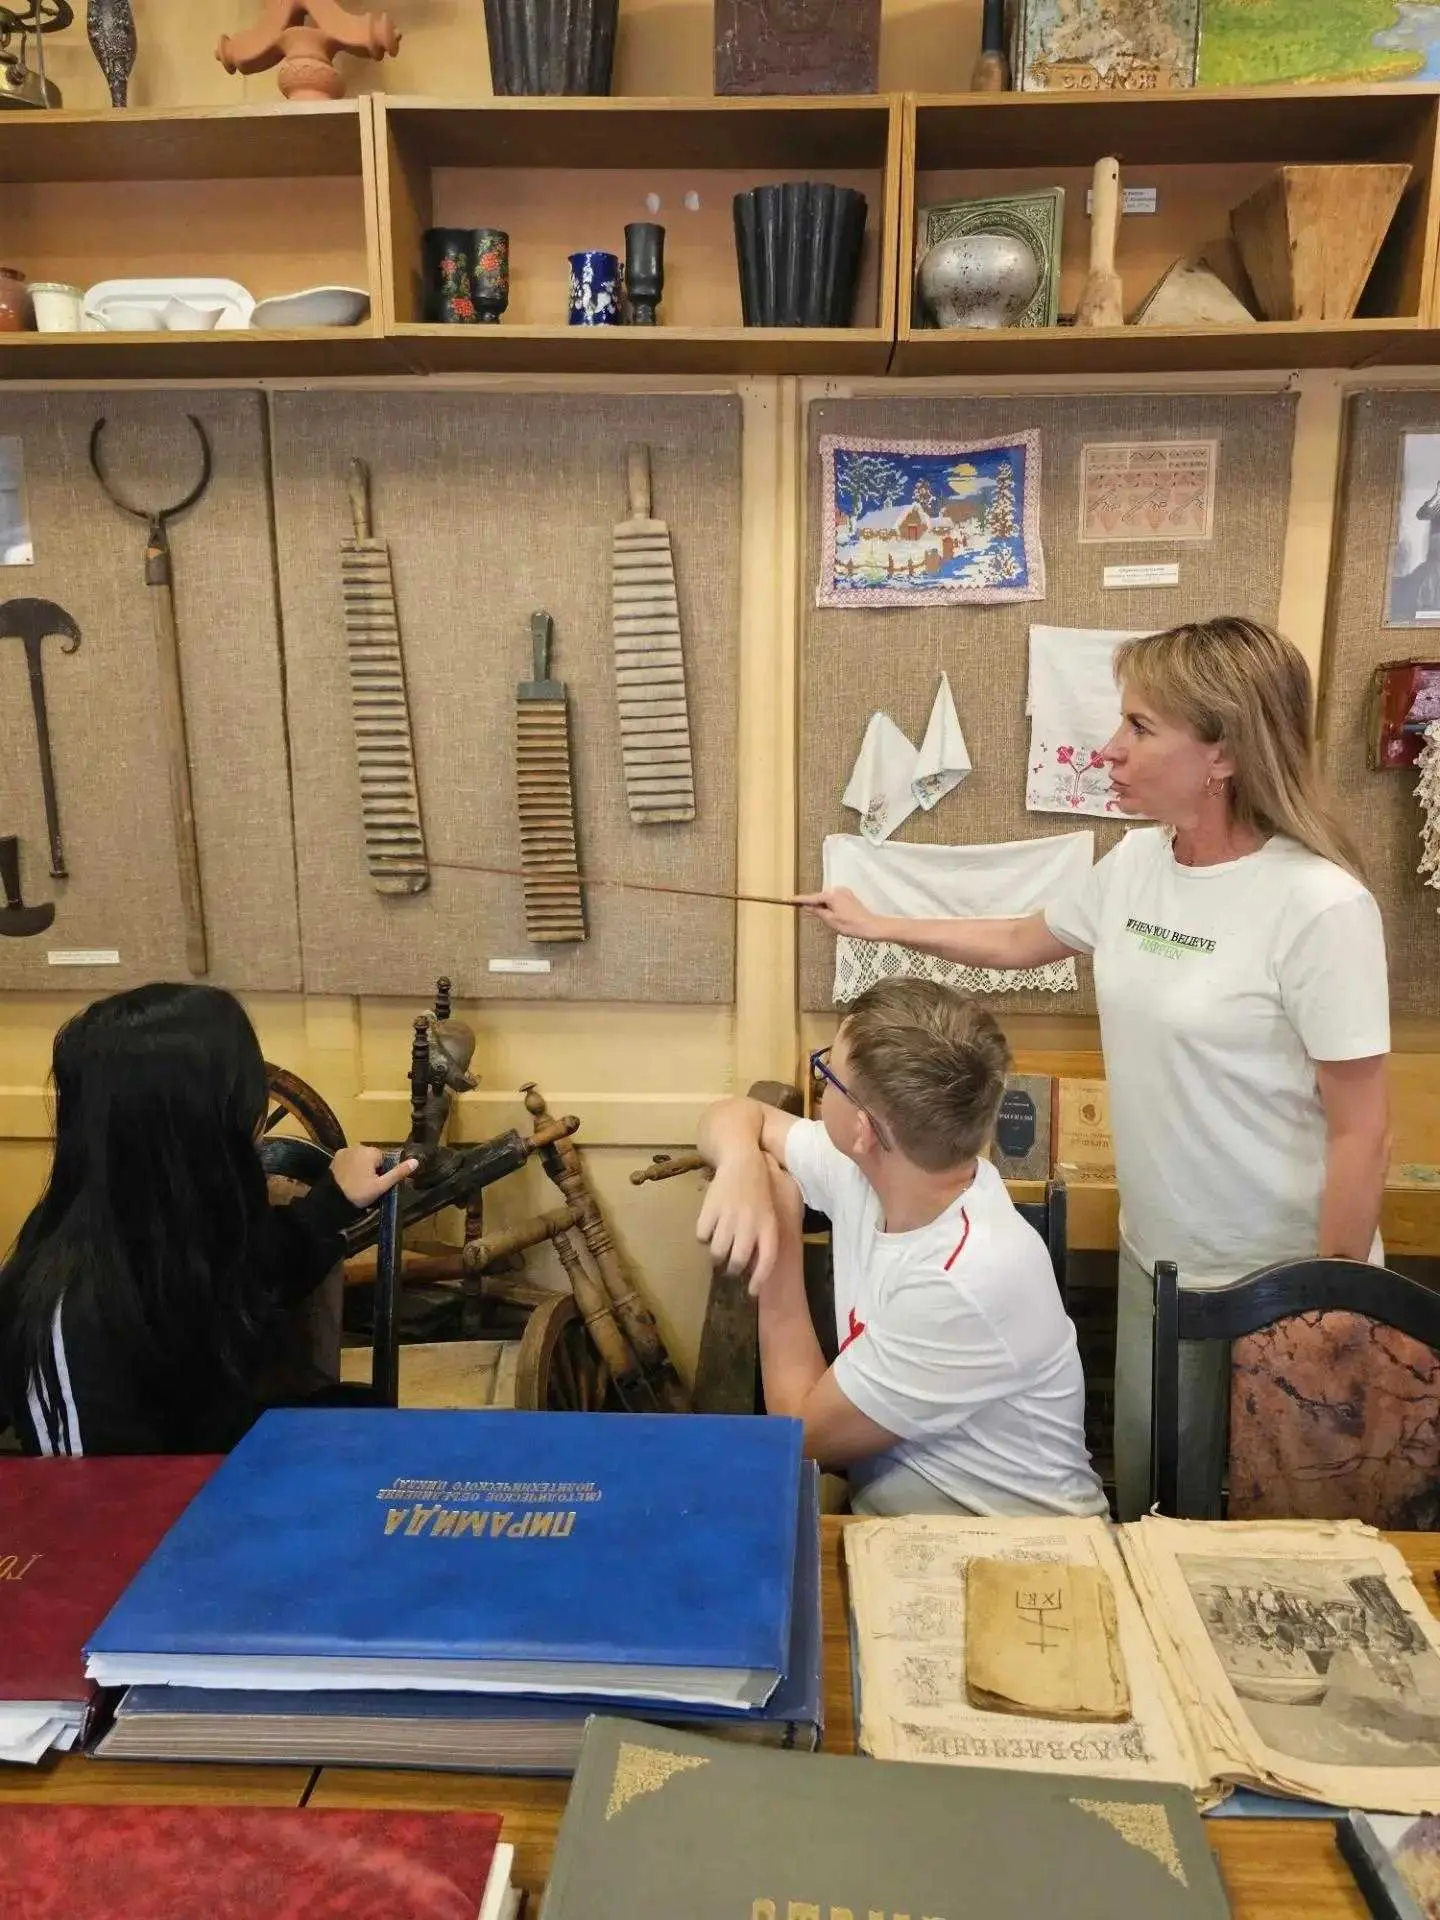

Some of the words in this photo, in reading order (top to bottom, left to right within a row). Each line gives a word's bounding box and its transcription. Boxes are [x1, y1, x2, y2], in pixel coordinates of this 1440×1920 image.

[1125, 918, 1154, 935] WHEN
[1152, 925, 1171, 940] YOU
[1171, 931, 1217, 952] BELIEVE
[384, 1503, 577, 1538] ПИРАМИДА
